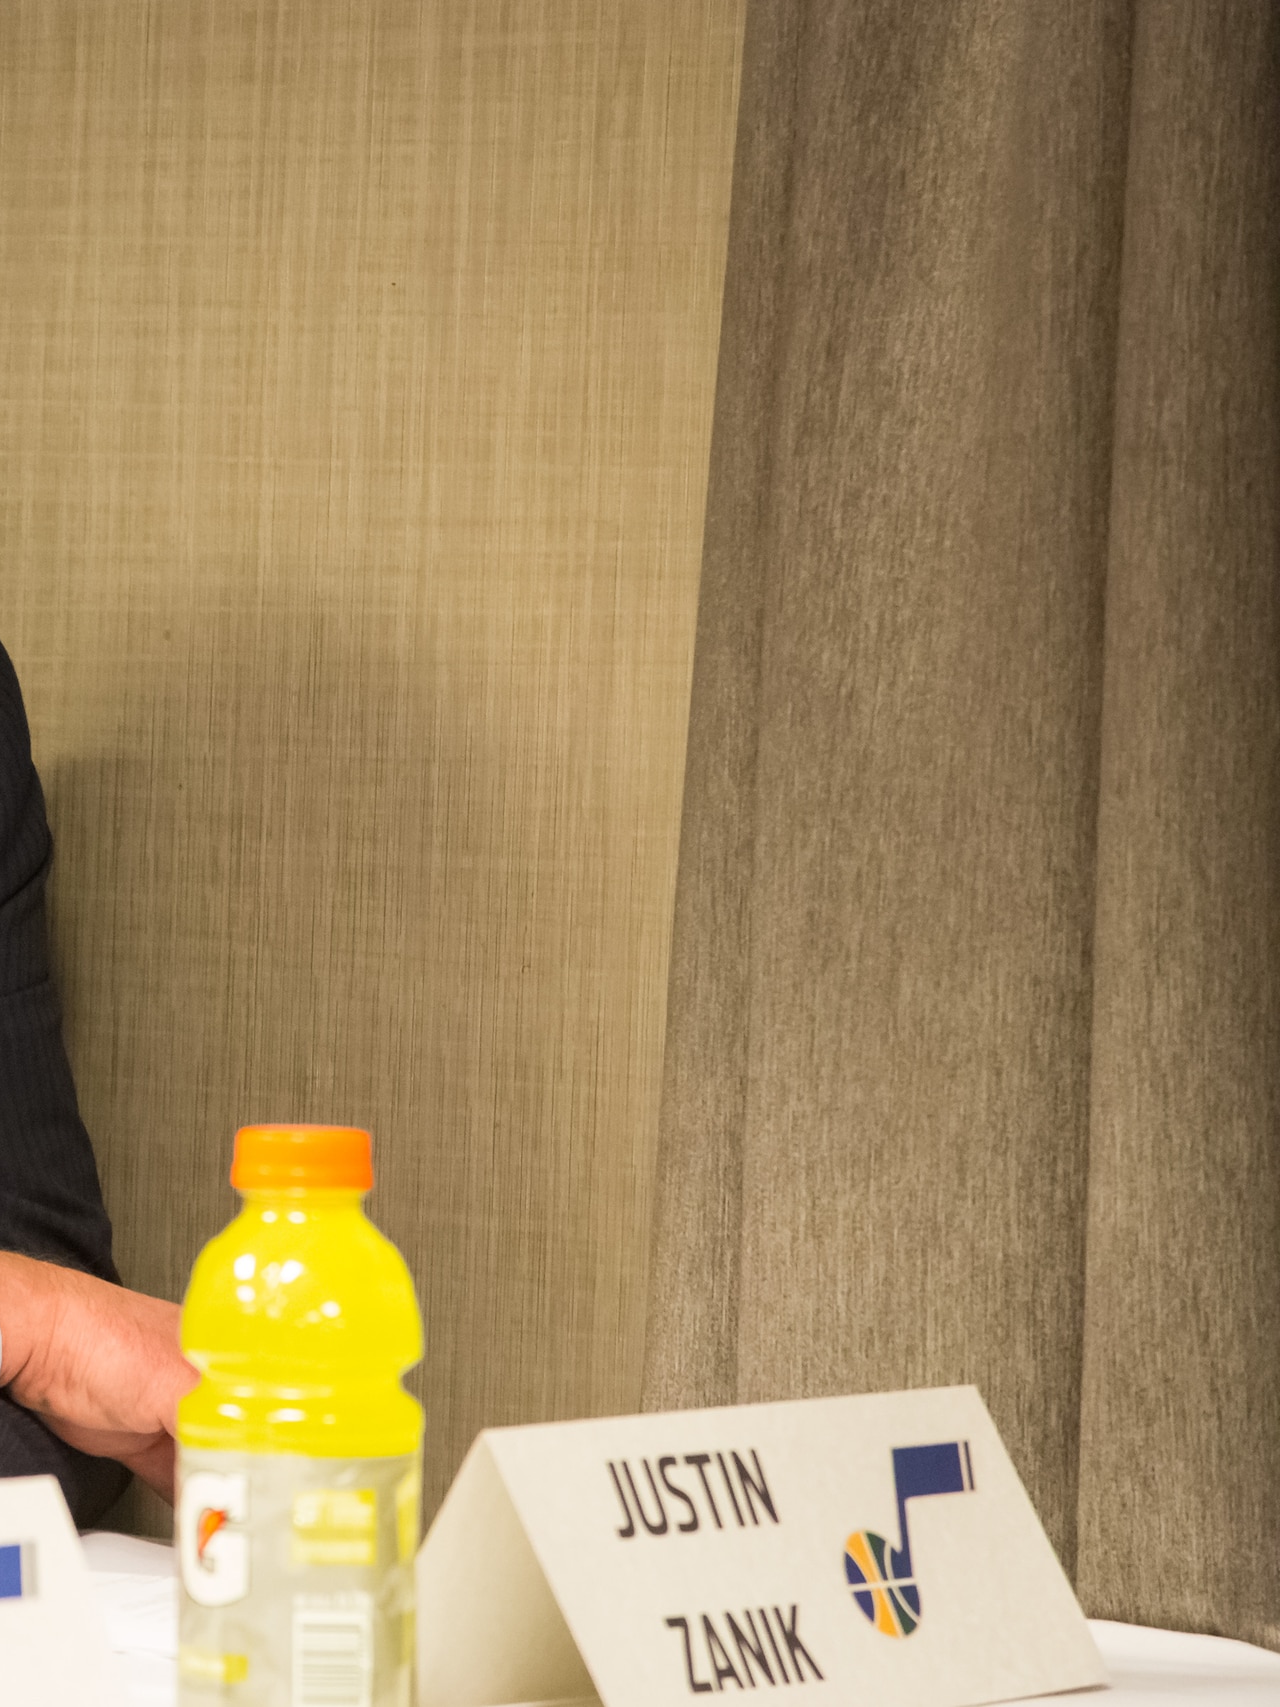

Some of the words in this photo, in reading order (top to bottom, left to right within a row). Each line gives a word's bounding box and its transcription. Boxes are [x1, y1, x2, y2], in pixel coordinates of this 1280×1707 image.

[181, 1472, 249, 1606] G
[608, 1449, 780, 1539] JUSTIN
[666, 1604, 826, 1694] ZANIK
